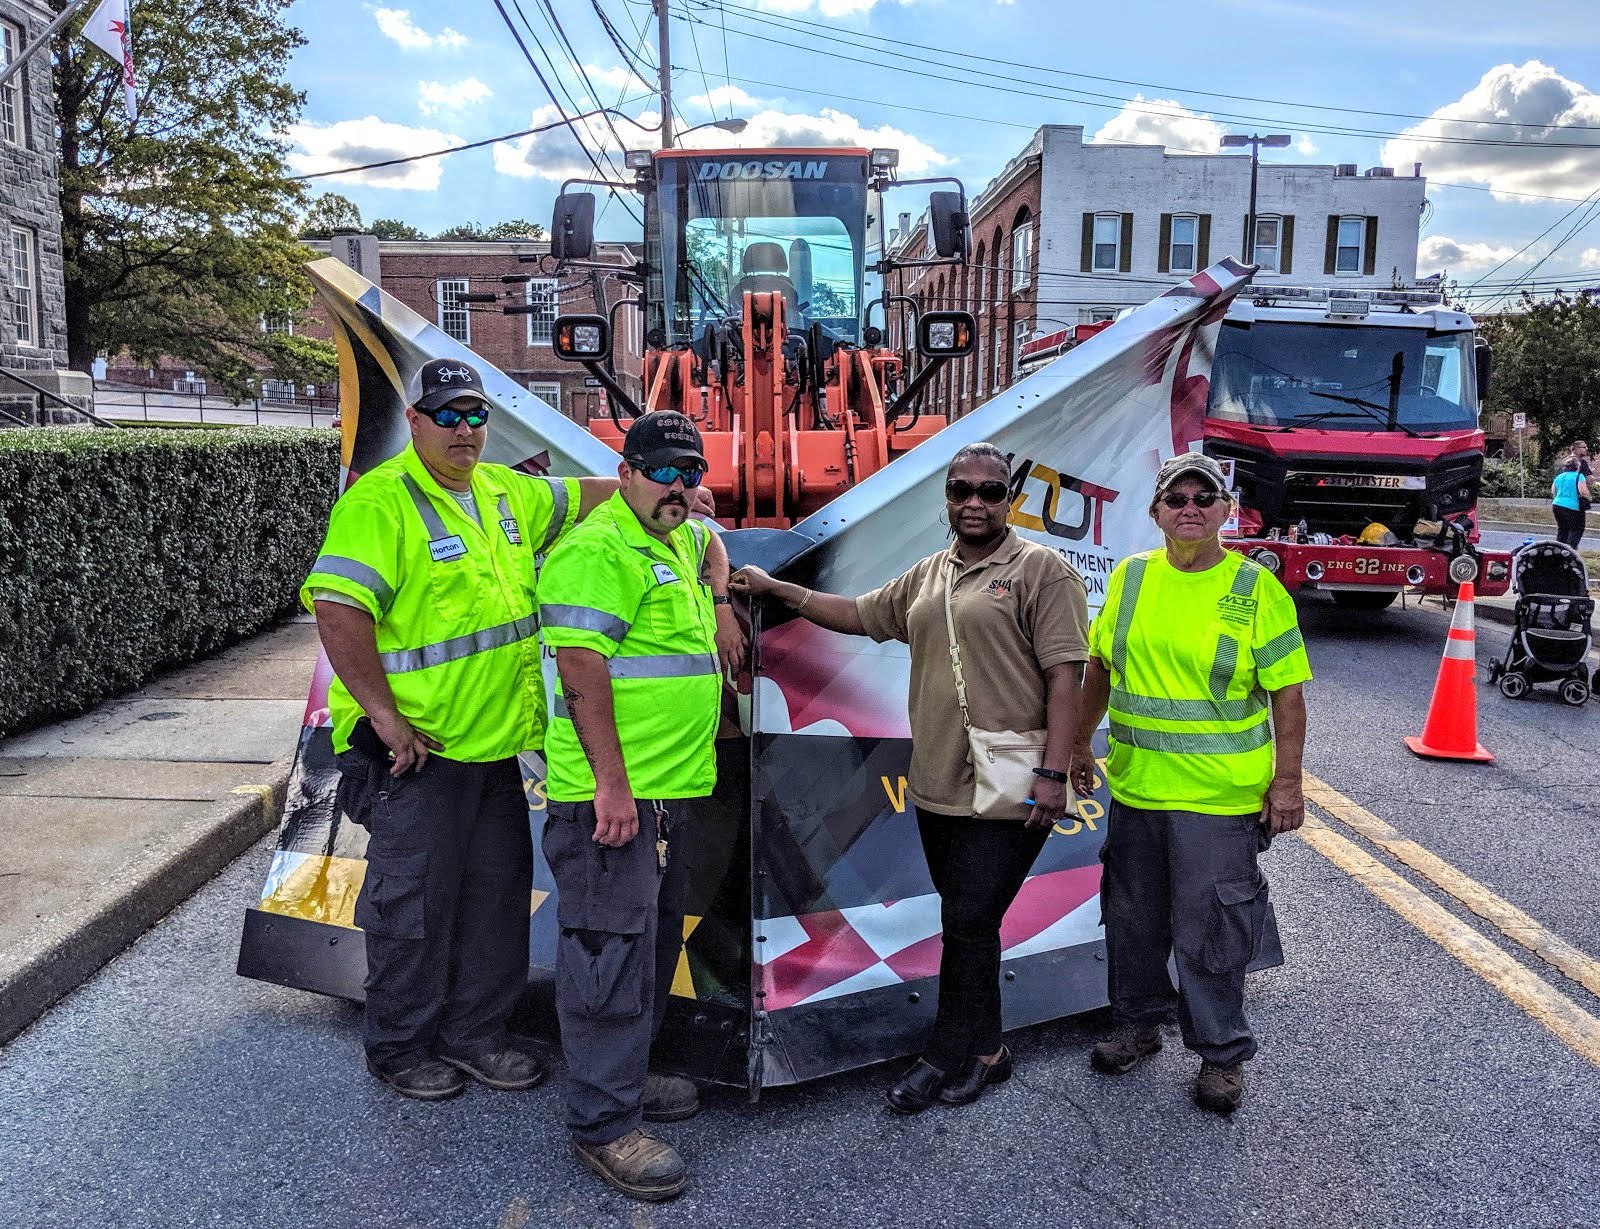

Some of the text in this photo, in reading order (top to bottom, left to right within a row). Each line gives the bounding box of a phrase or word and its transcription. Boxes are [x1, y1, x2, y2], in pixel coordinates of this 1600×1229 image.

[698, 161, 828, 180] DOOSAN
[432, 543, 460, 556] Horton
[1327, 558, 1405, 575] ENG 32 INE
